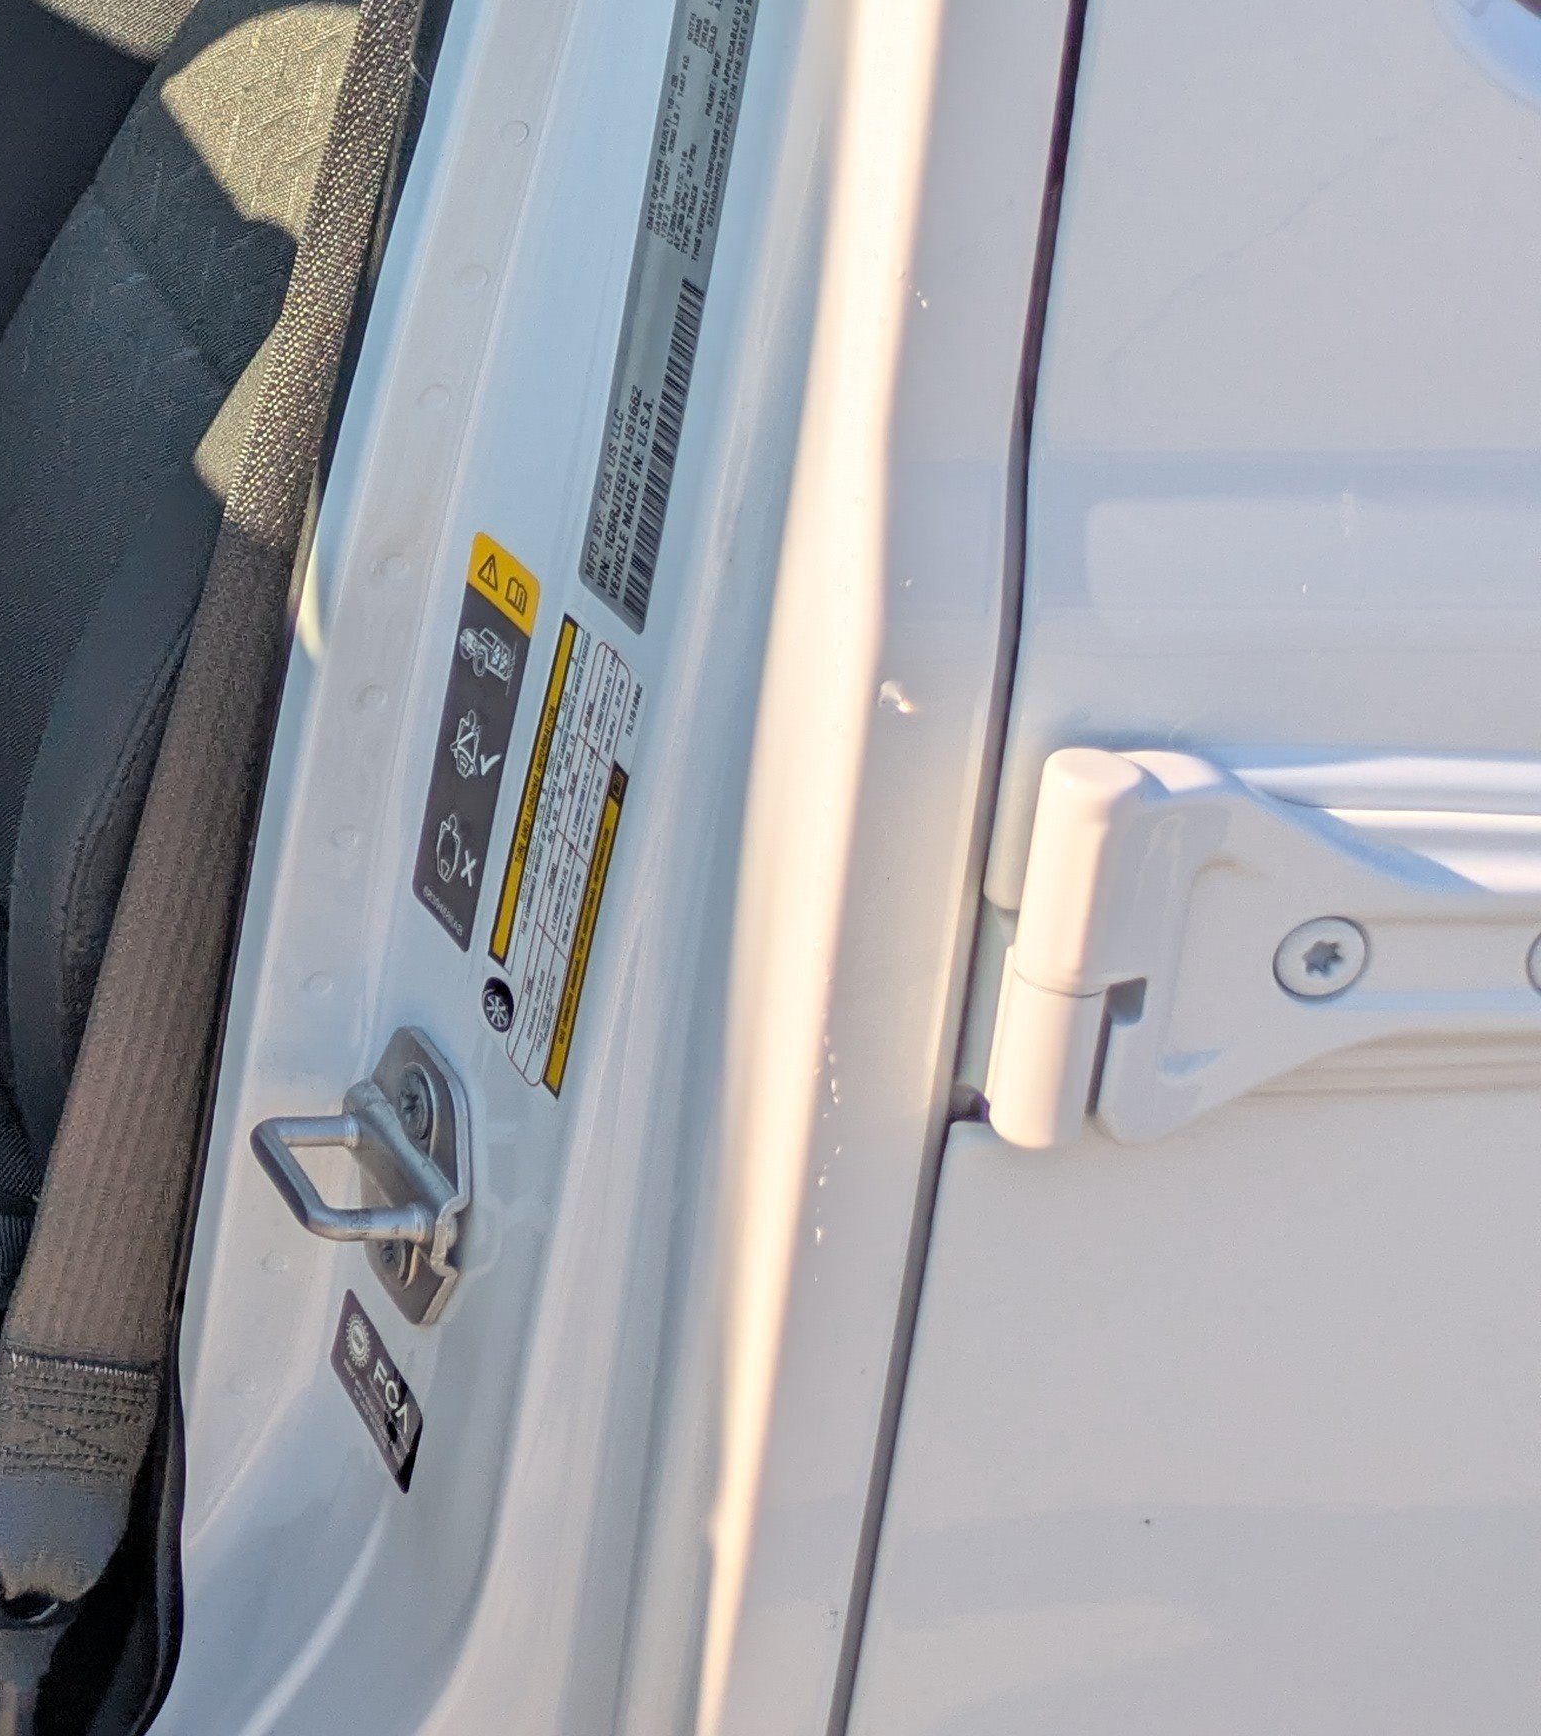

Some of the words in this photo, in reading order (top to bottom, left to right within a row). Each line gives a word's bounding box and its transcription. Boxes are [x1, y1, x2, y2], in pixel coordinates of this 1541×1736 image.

[721, 16, 740, 86] APPLICABLE
[717, 86, 728, 108] ALL
[706, 160, 724, 228] STANDARDS
[720, 102, 734, 144] EFFECT
[736, 26, 748, 57] DATE
[703, 127, 721, 189] CONFORMS
[645, 200, 656, 231] DATE
[686, 183, 699, 220] TRUCK
[695, 190, 710, 236] VEHICLE
[690, 235, 701, 263] THIS
[610, 405, 625, 441] LLC
[635, 393, 654, 448] U.S.A.
[605, 441, 618, 468] US
[630, 448, 644, 477] IN:
[598, 470, 613, 506] FCA
[621, 477, 639, 530] MADE
[592, 509, 605, 540] BY:
[585, 541, 600, 580] MFD
[596, 555, 611, 590] VIN:
[608, 529, 628, 601] VEHICLE
